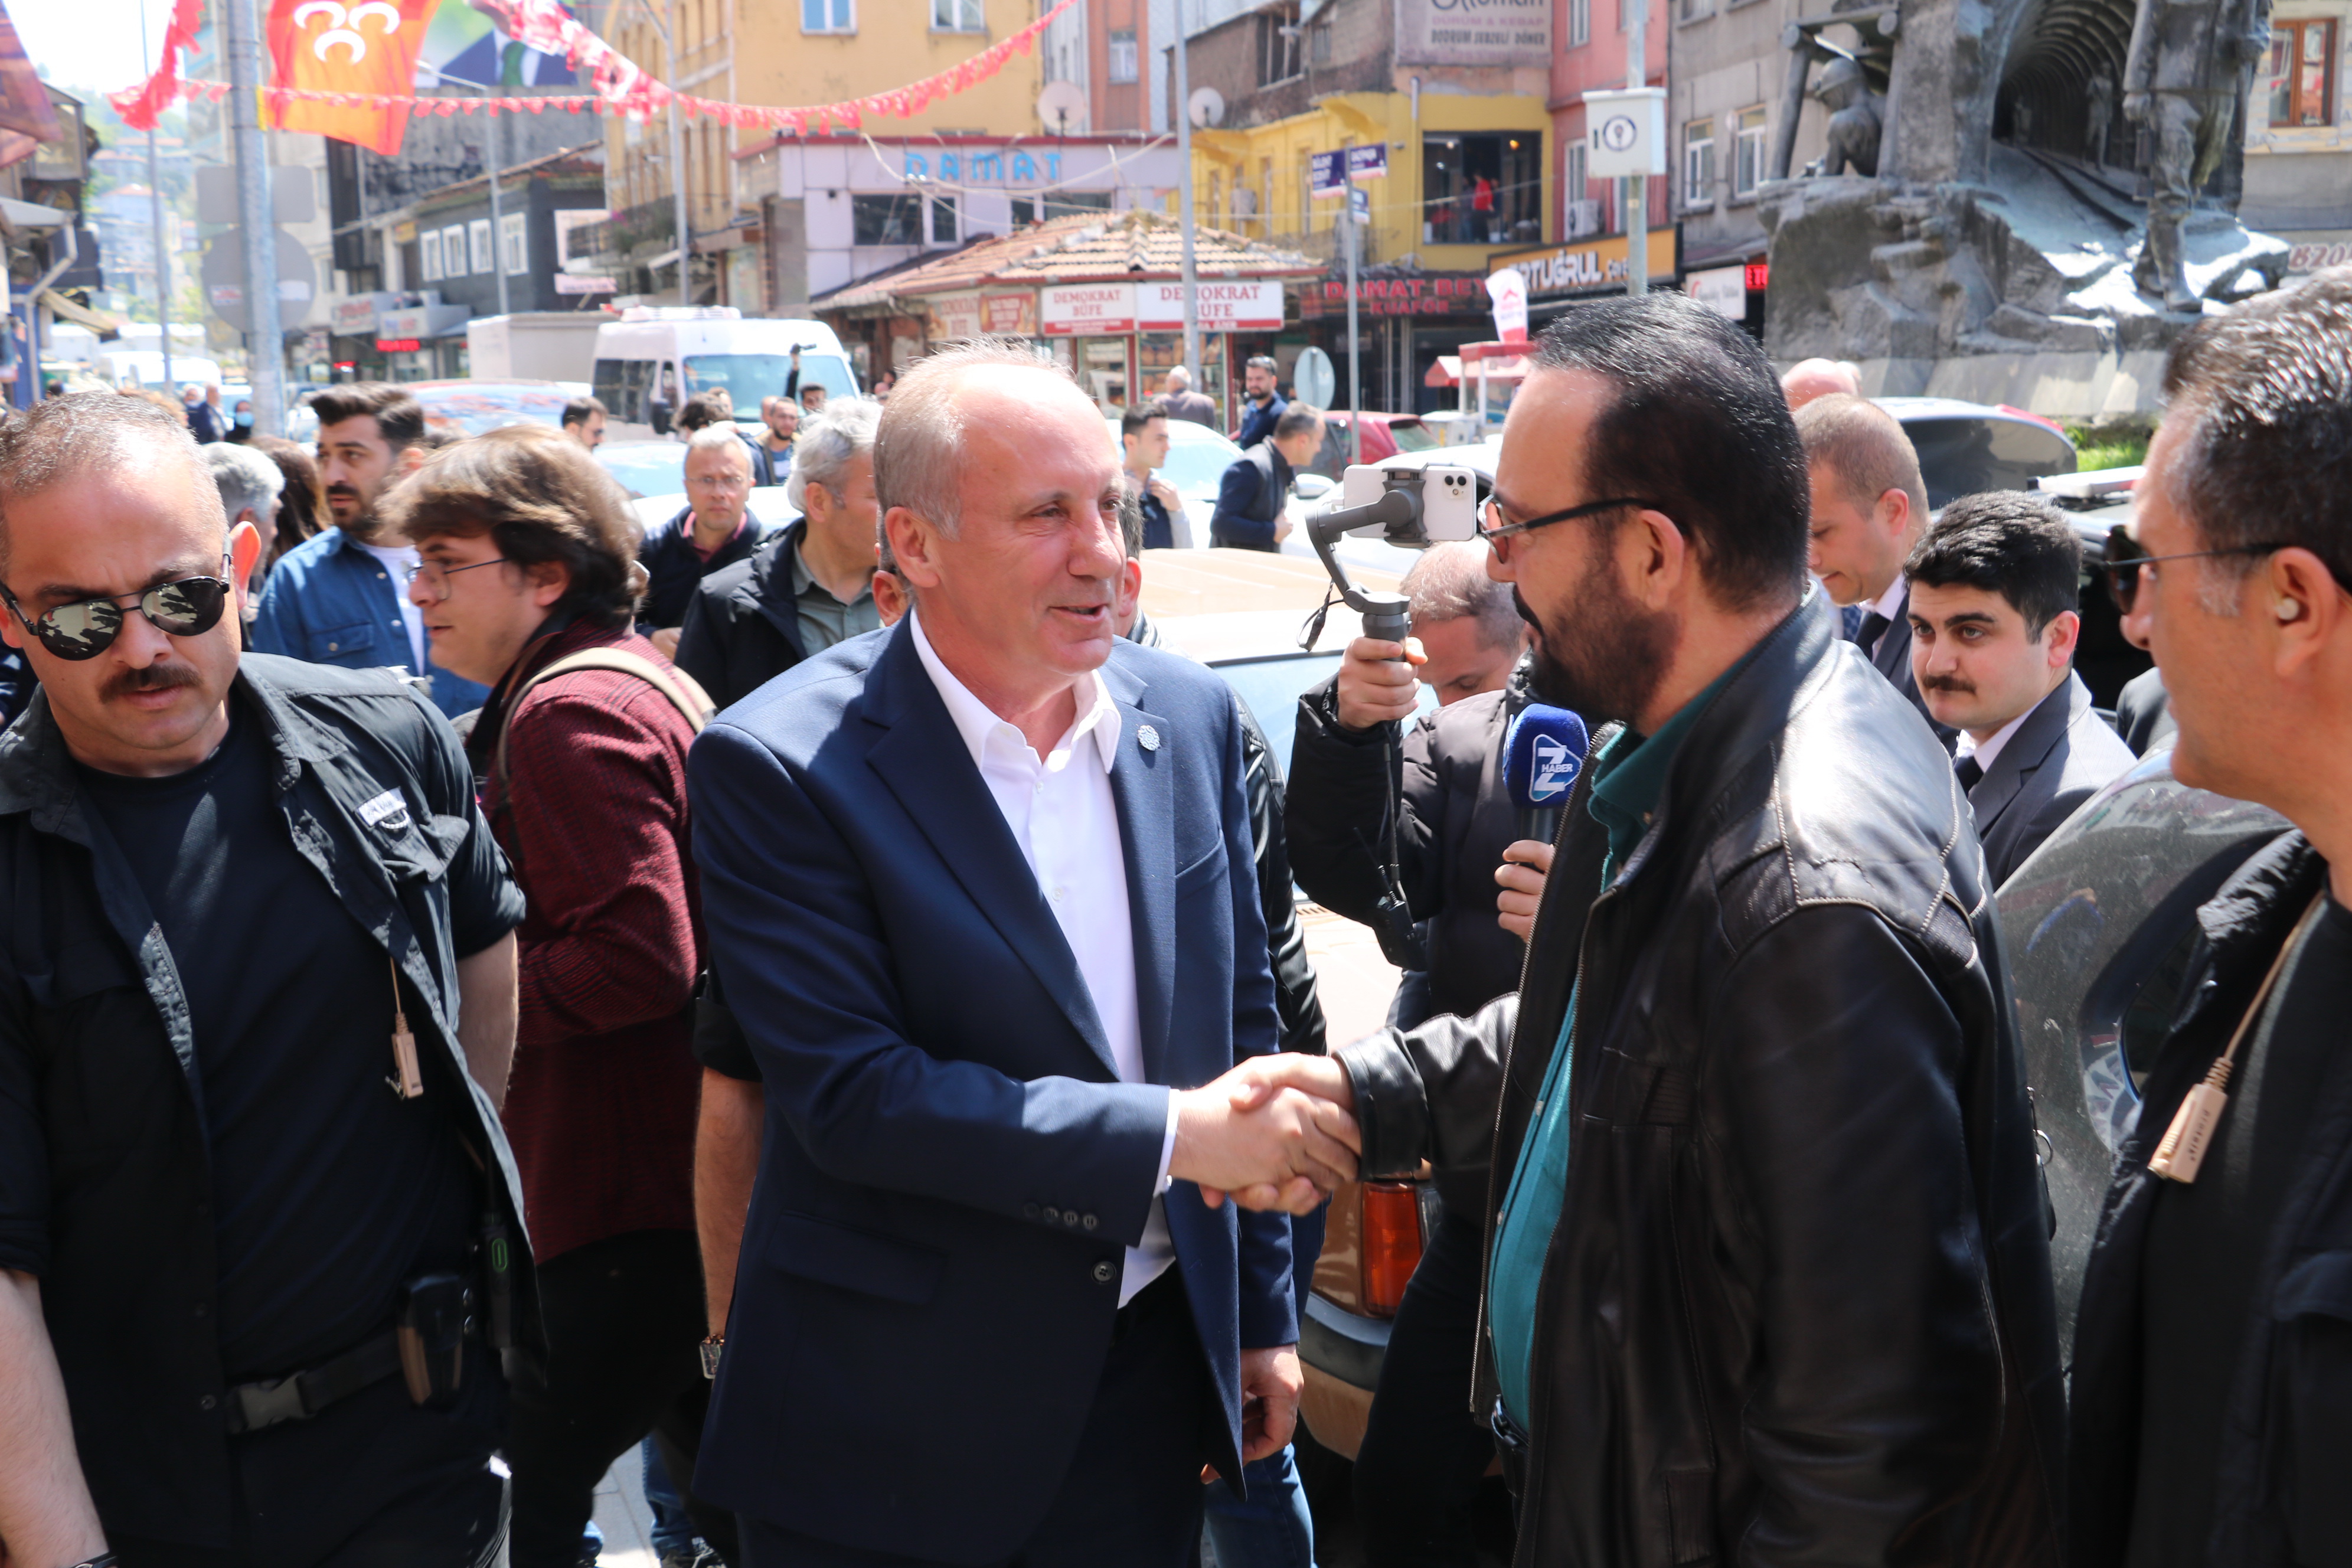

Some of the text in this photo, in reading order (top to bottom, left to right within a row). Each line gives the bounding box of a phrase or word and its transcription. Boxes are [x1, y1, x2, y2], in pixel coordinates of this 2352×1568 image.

[905, 153, 1061, 179] DAMAT
[1509, 249, 1603, 289] RTUĞRUL
[1054, 289, 1121, 304] DEMOKRAT
[1161, 286, 1261, 301] DEOKRAT
[1072, 302, 1103, 316] BÜFE
[1196, 302, 1234, 318] ÜFE
[1541, 763, 1573, 773] HABER
